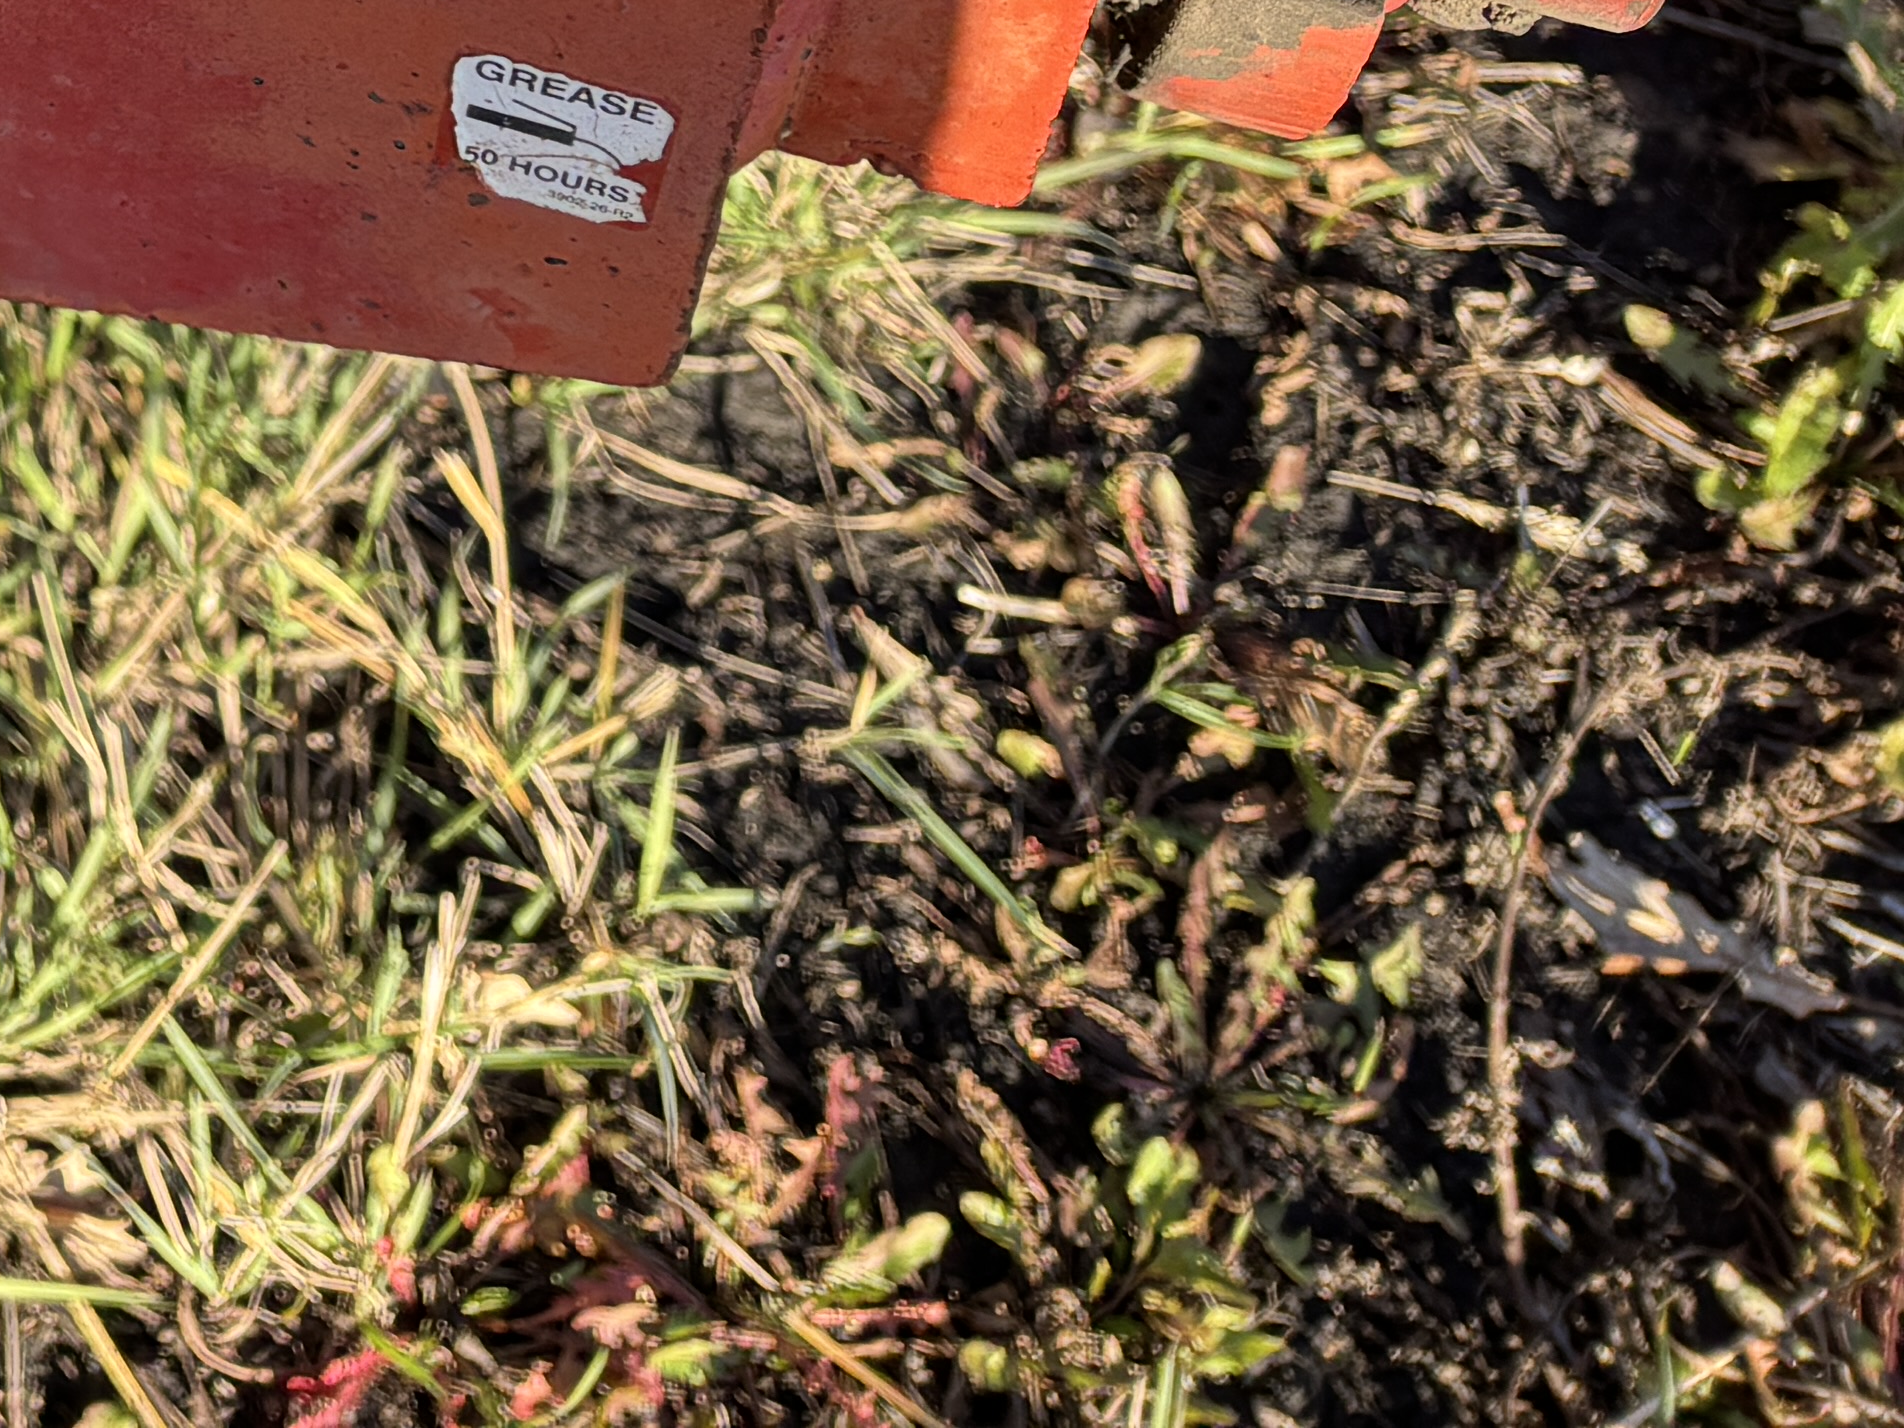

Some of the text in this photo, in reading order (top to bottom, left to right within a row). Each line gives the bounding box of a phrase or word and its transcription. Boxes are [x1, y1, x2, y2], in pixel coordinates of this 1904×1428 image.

[475, 59, 658, 126] GREASE
[464, 145, 631, 204] 50 HOURS
